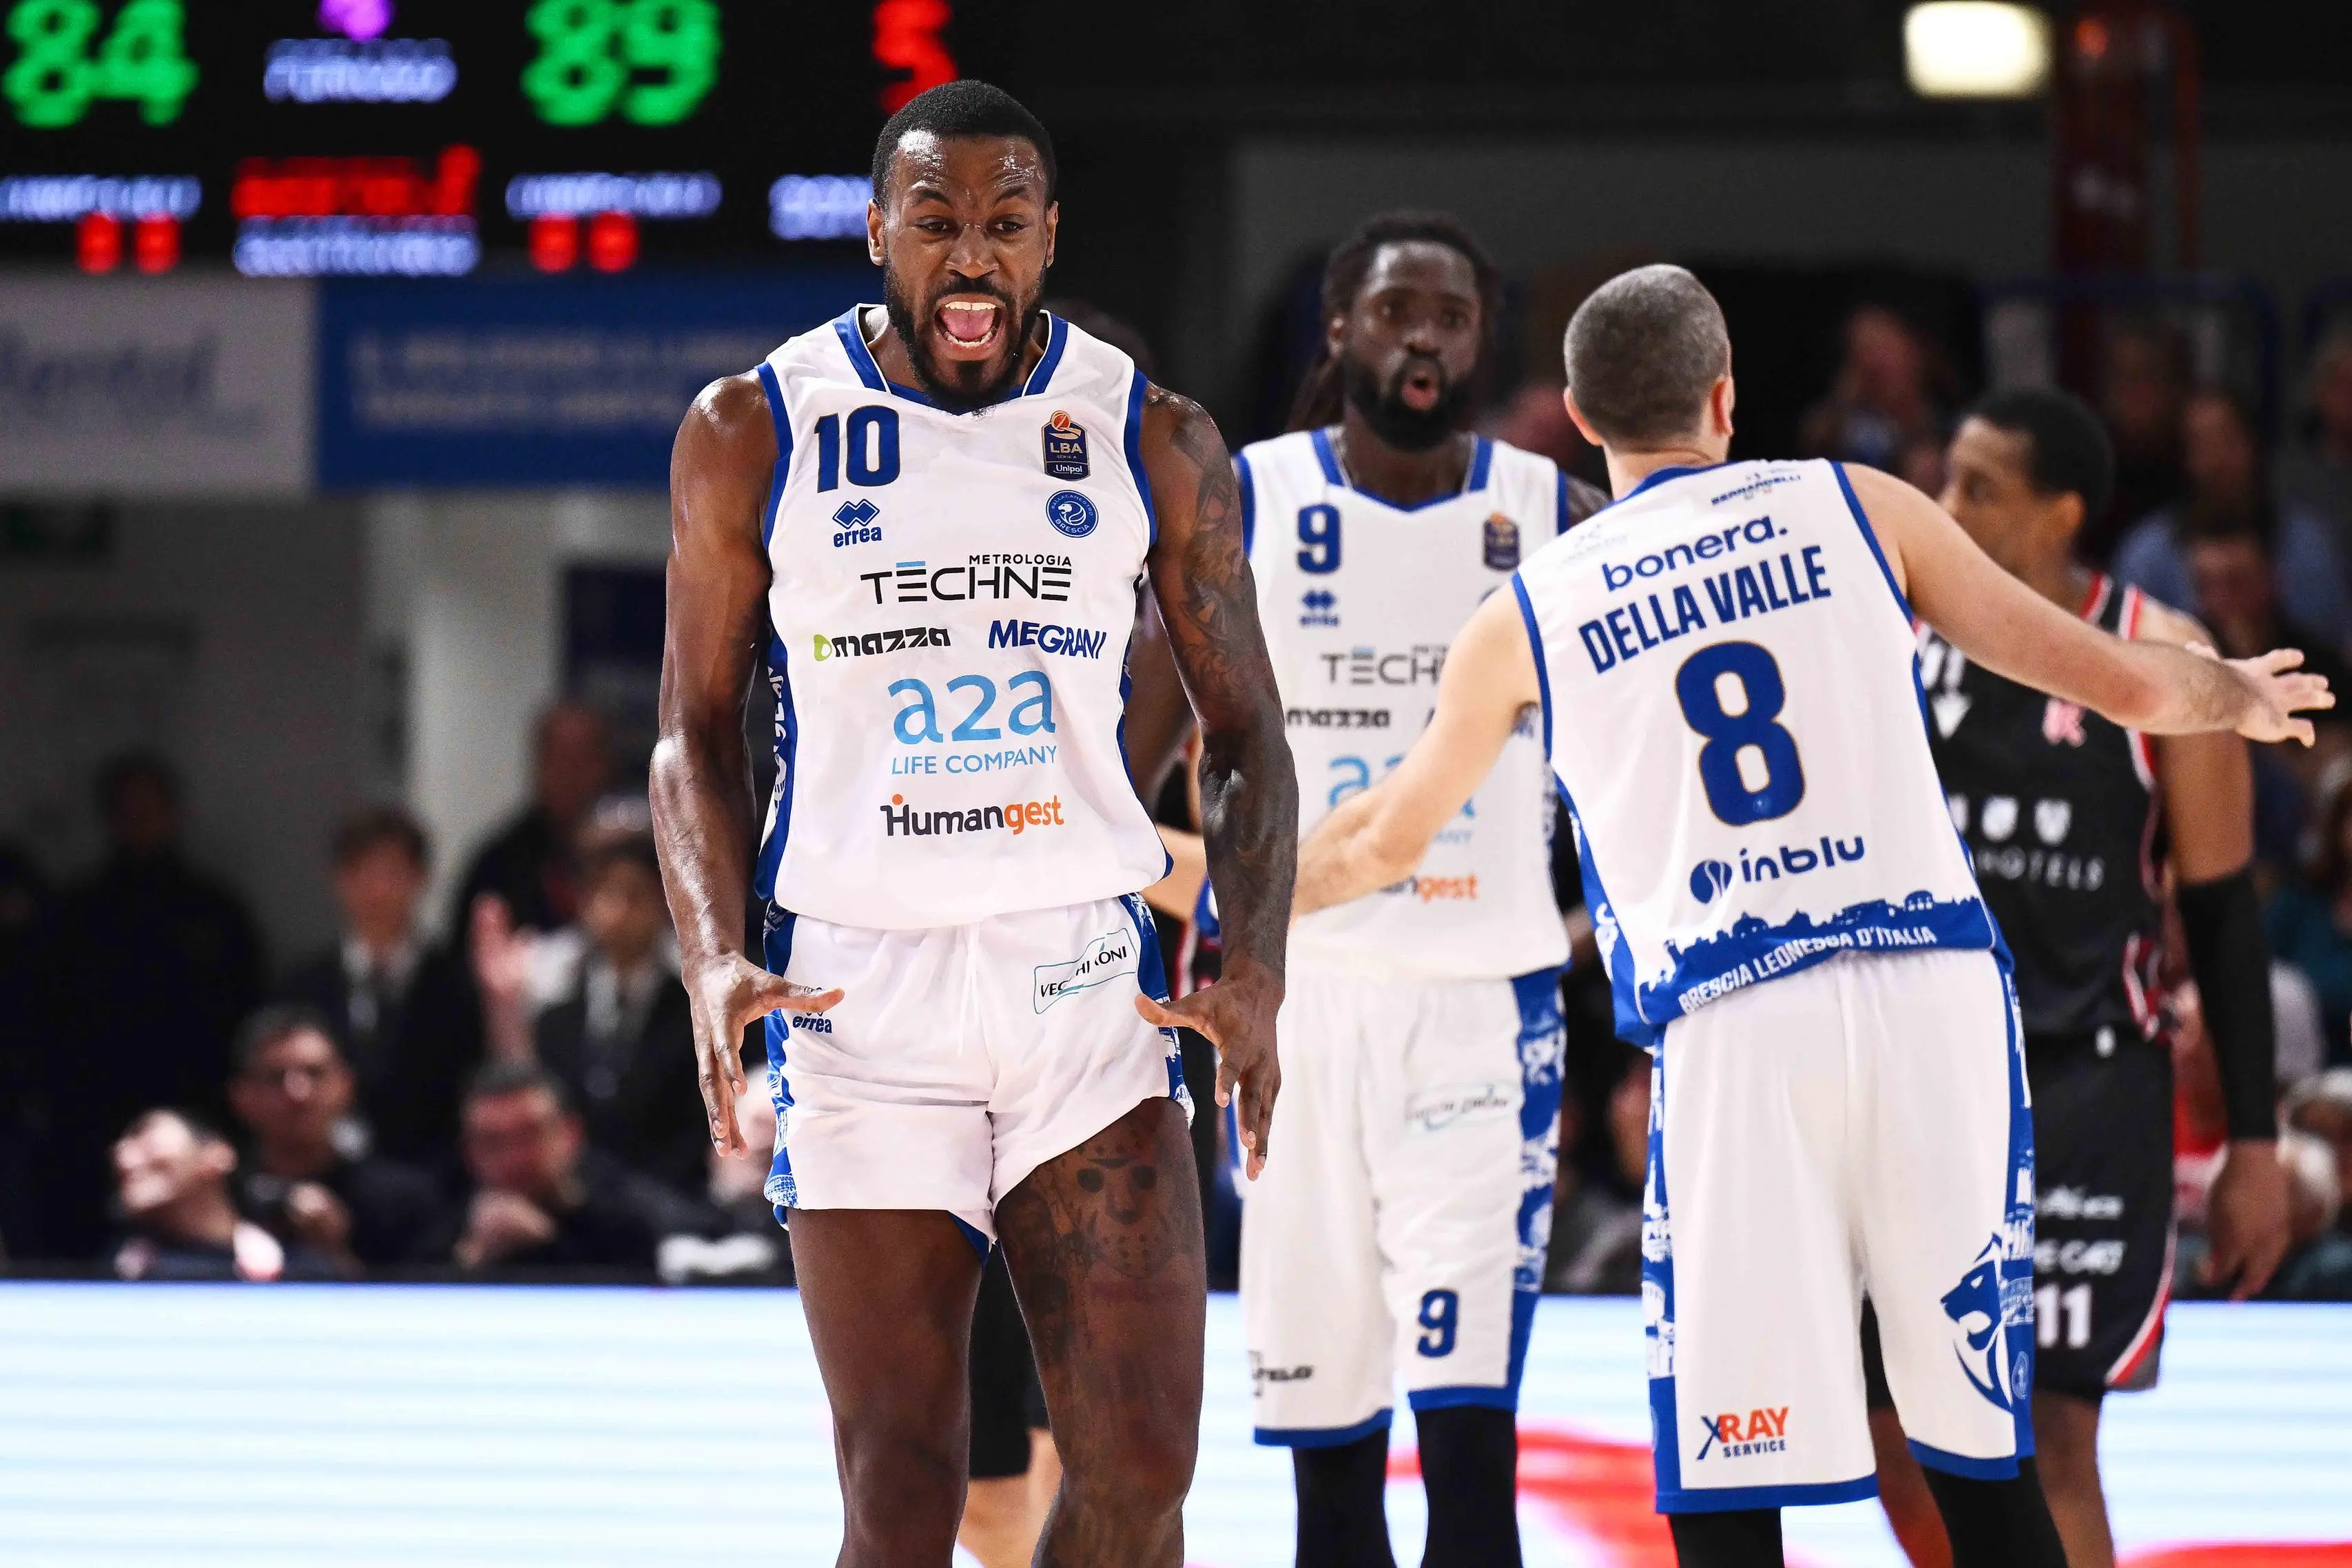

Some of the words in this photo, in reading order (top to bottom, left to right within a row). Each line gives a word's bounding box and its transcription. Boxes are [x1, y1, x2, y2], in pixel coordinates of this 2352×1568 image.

[2, 0, 200, 127] 84
[520, 0, 723, 127] 89
[814, 404, 900, 493] 10
[1050, 442, 1083, 453] LBA
[1055, 464, 1082, 475] Unipol
[833, 525, 883, 548] errea
[1055, 518, 1090, 534] BRESCIA
[1297, 502, 1342, 574] 9
[1602, 515, 1788, 592] bonera.
[968, 554, 1073, 567] METROLOGIA
[1578, 584, 1707, 674] DELLA
[1703, 544, 1832, 623] VALLE
[988, 619, 1107, 660] MEGRANI
[888, 668, 1057, 745] a2a
[1675, 639, 1806, 827] 8
[891, 756, 938, 775] LIFE
[945, 745, 1058, 774] COMPANY
[880, 794, 1065, 836] Humangest
[1740, 835, 1866, 883] inblu
[1678, 963, 1755, 1016] BRESCIA
[1855, 925, 1937, 948] D'ITALIA
[792, 1015, 832, 1033] errea
[1417, 1287, 1460, 1359] 9
[2034, 1282, 2092, 1349] 11
[1723, 1438, 1786, 1458] SERVICE
